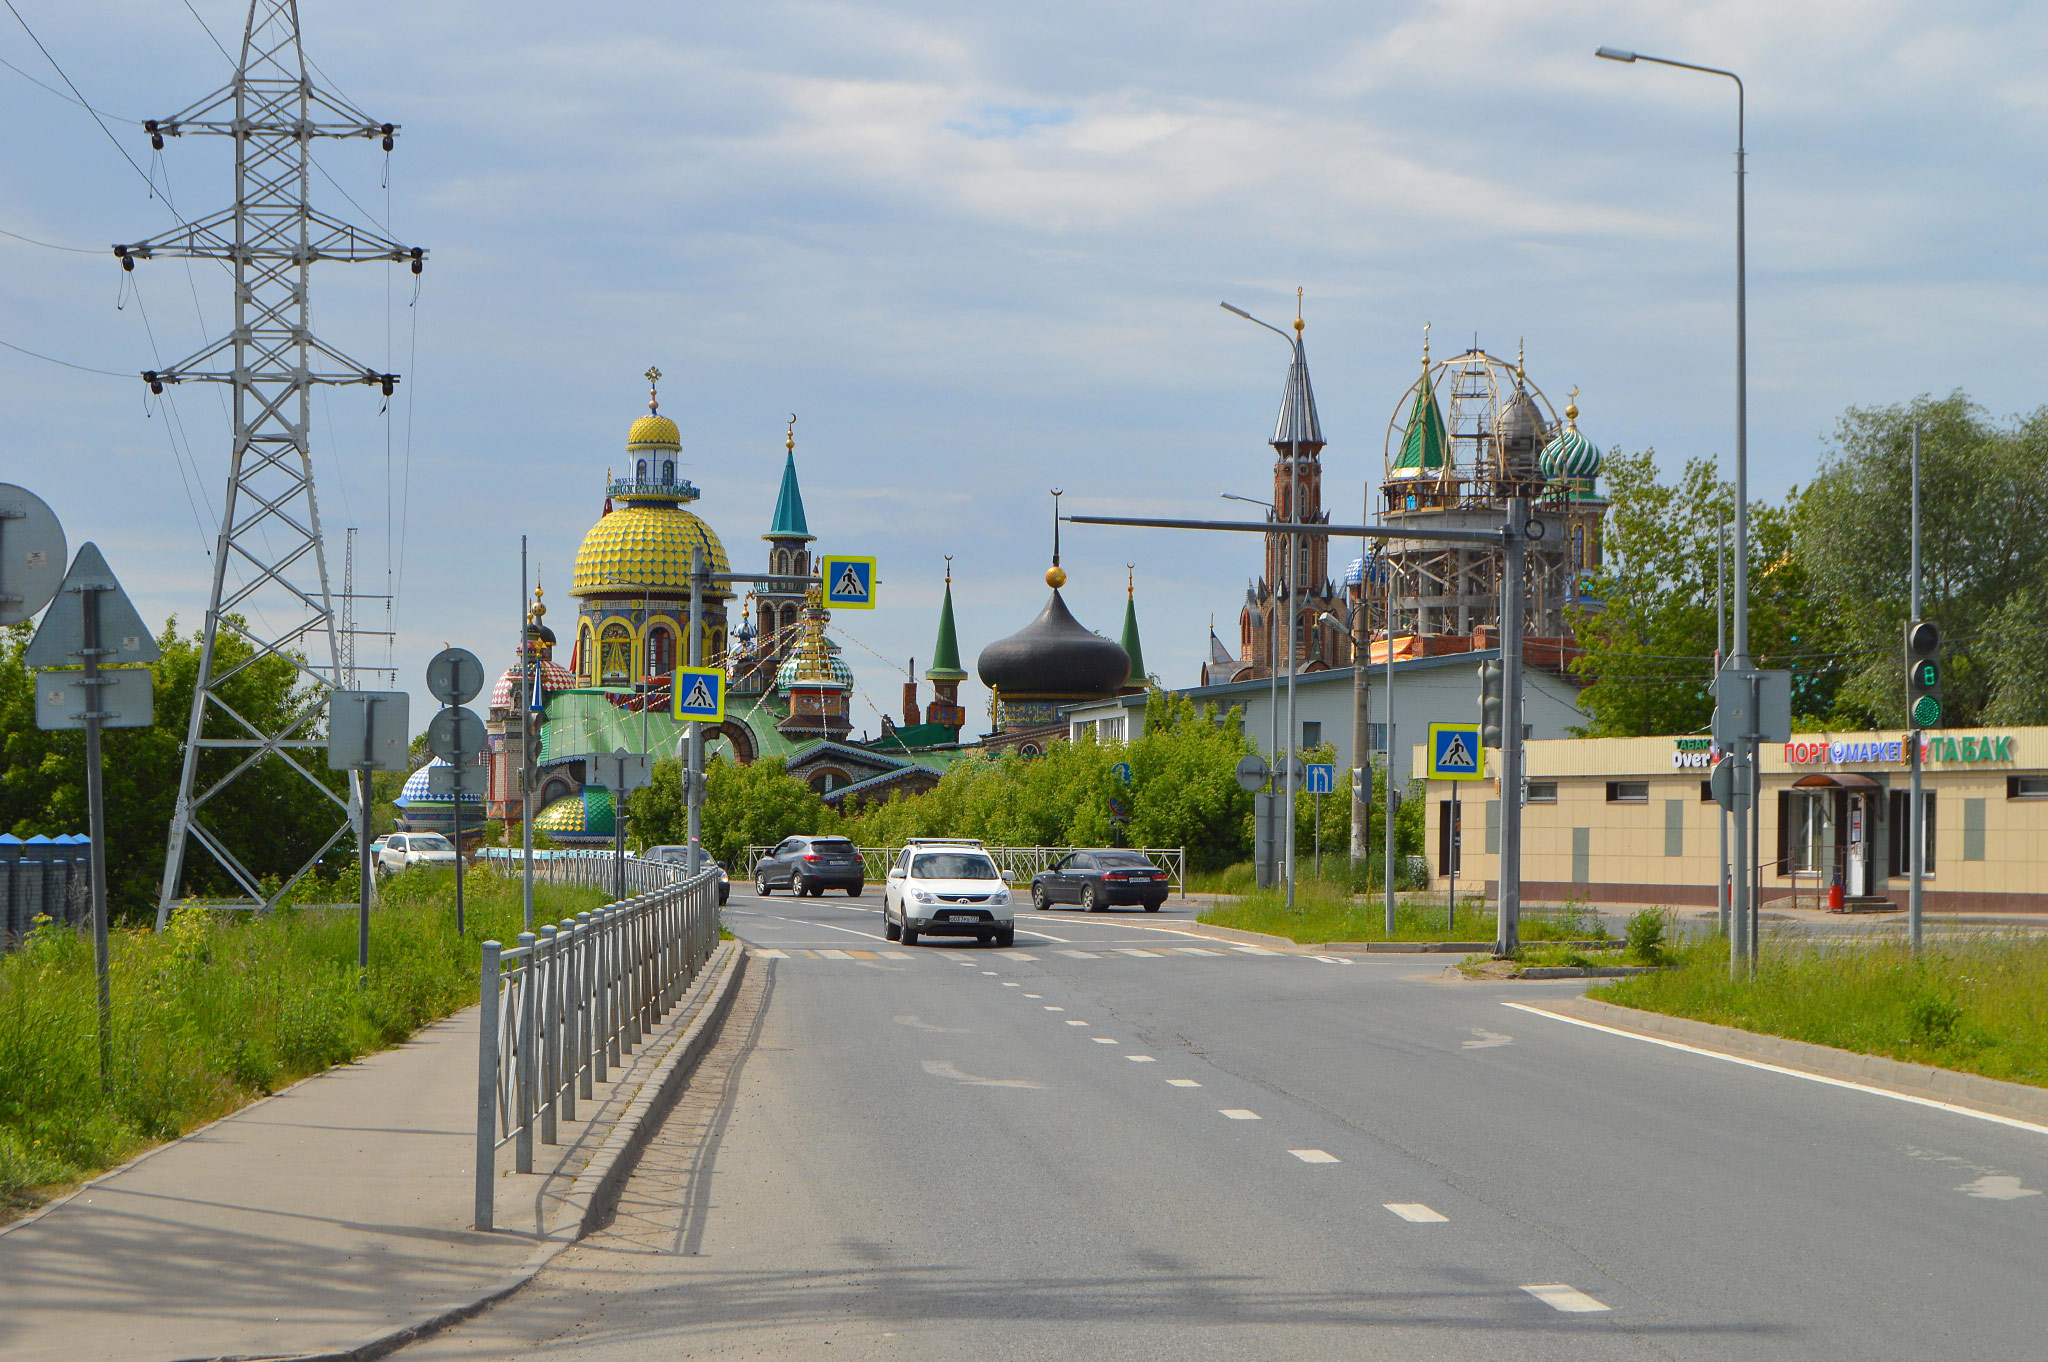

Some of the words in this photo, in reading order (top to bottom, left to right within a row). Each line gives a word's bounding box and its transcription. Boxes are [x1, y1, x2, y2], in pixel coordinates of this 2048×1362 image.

[1924, 666, 1935, 686] 8
[1674, 739, 1711, 750] ТАБАК
[1784, 743, 1830, 764] ПОРТ
[1845, 742, 1902, 762] МАРКЕТ
[1931, 736, 2013, 762] ТАБАК
[1672, 751, 1710, 768] Over
